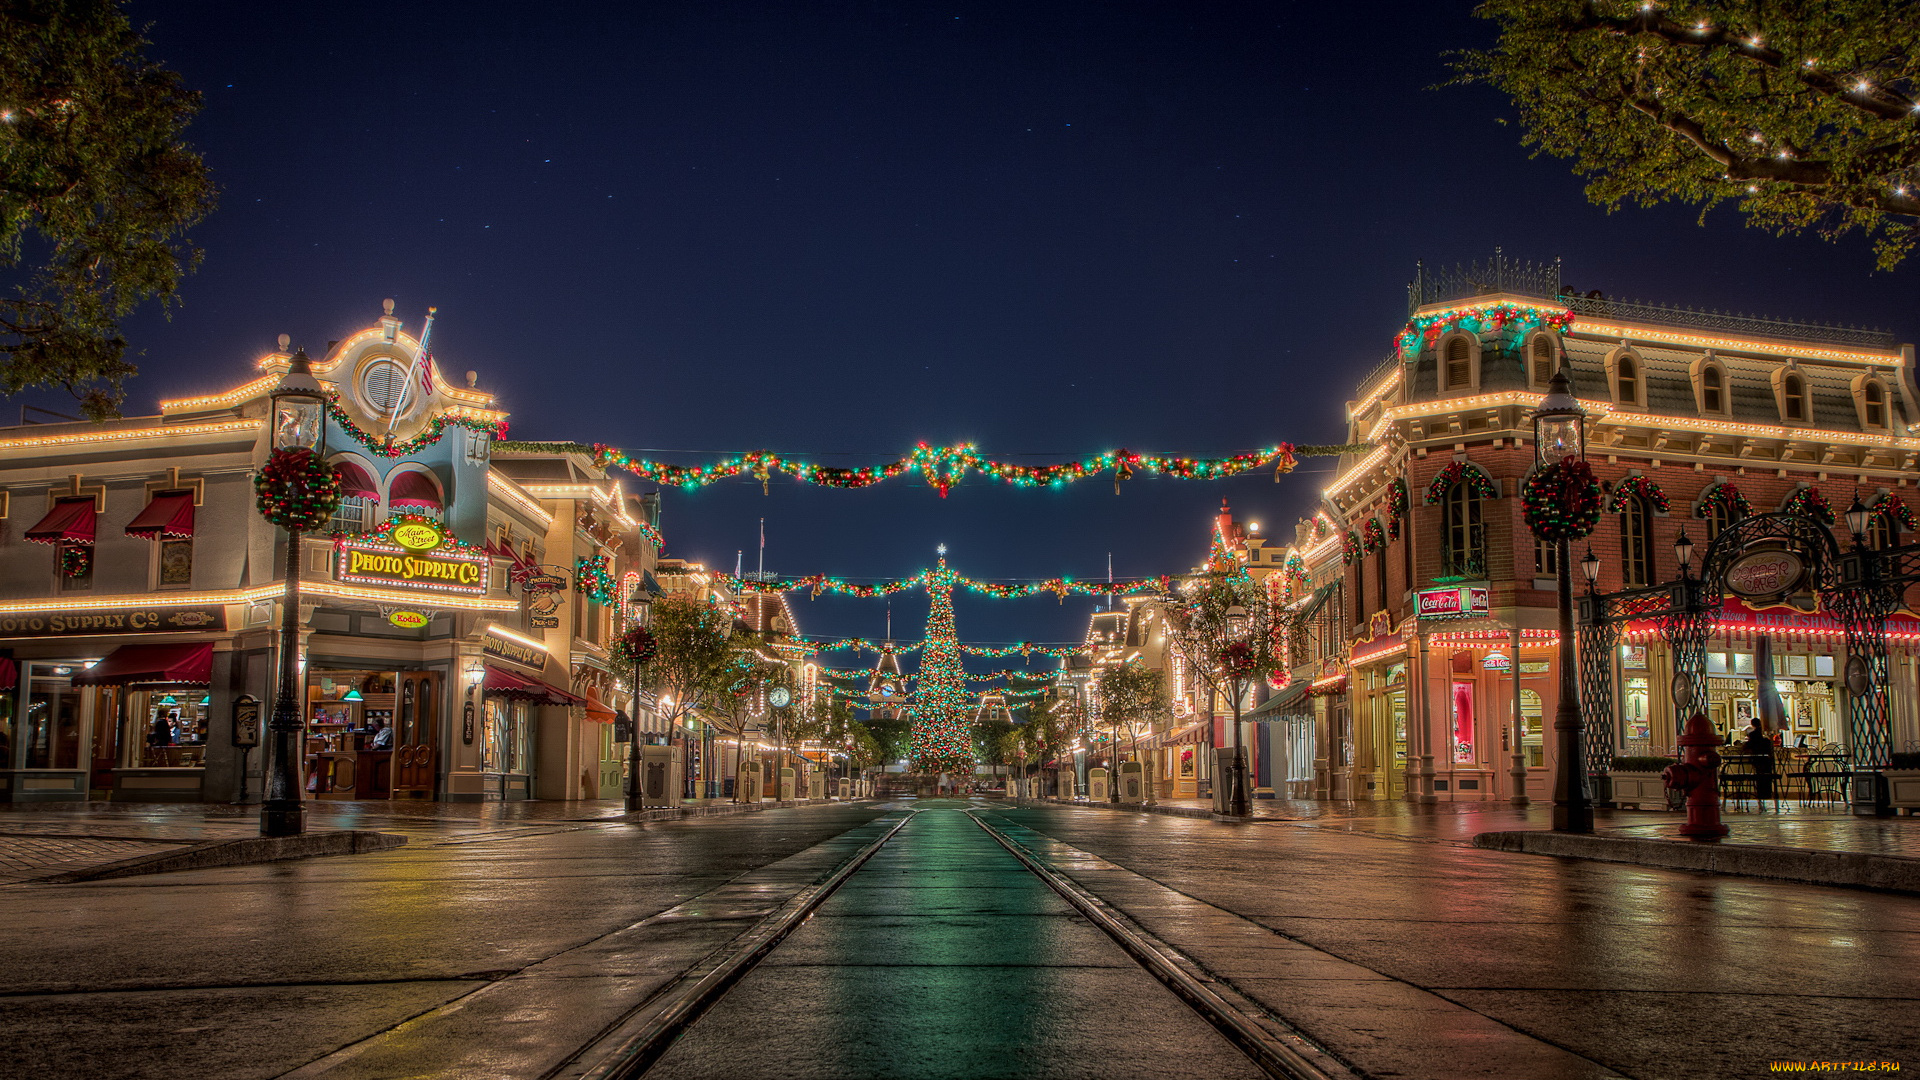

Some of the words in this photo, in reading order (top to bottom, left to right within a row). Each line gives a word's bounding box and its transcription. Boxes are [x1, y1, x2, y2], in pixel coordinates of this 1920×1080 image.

[399, 527, 430, 538] Main
[408, 535, 435, 546] Street
[350, 550, 402, 573] PHOTO
[402, 556, 459, 579] SUPPLY
[1733, 562, 1789, 580] CORNER
[0, 618, 44, 631] OTO
[50, 614, 125, 632] SUPPLY
[396, 614, 422, 624] Kodak
[1756, 613, 1847, 630] REFRESHME
[501, 641, 525, 659] SUPPLY
